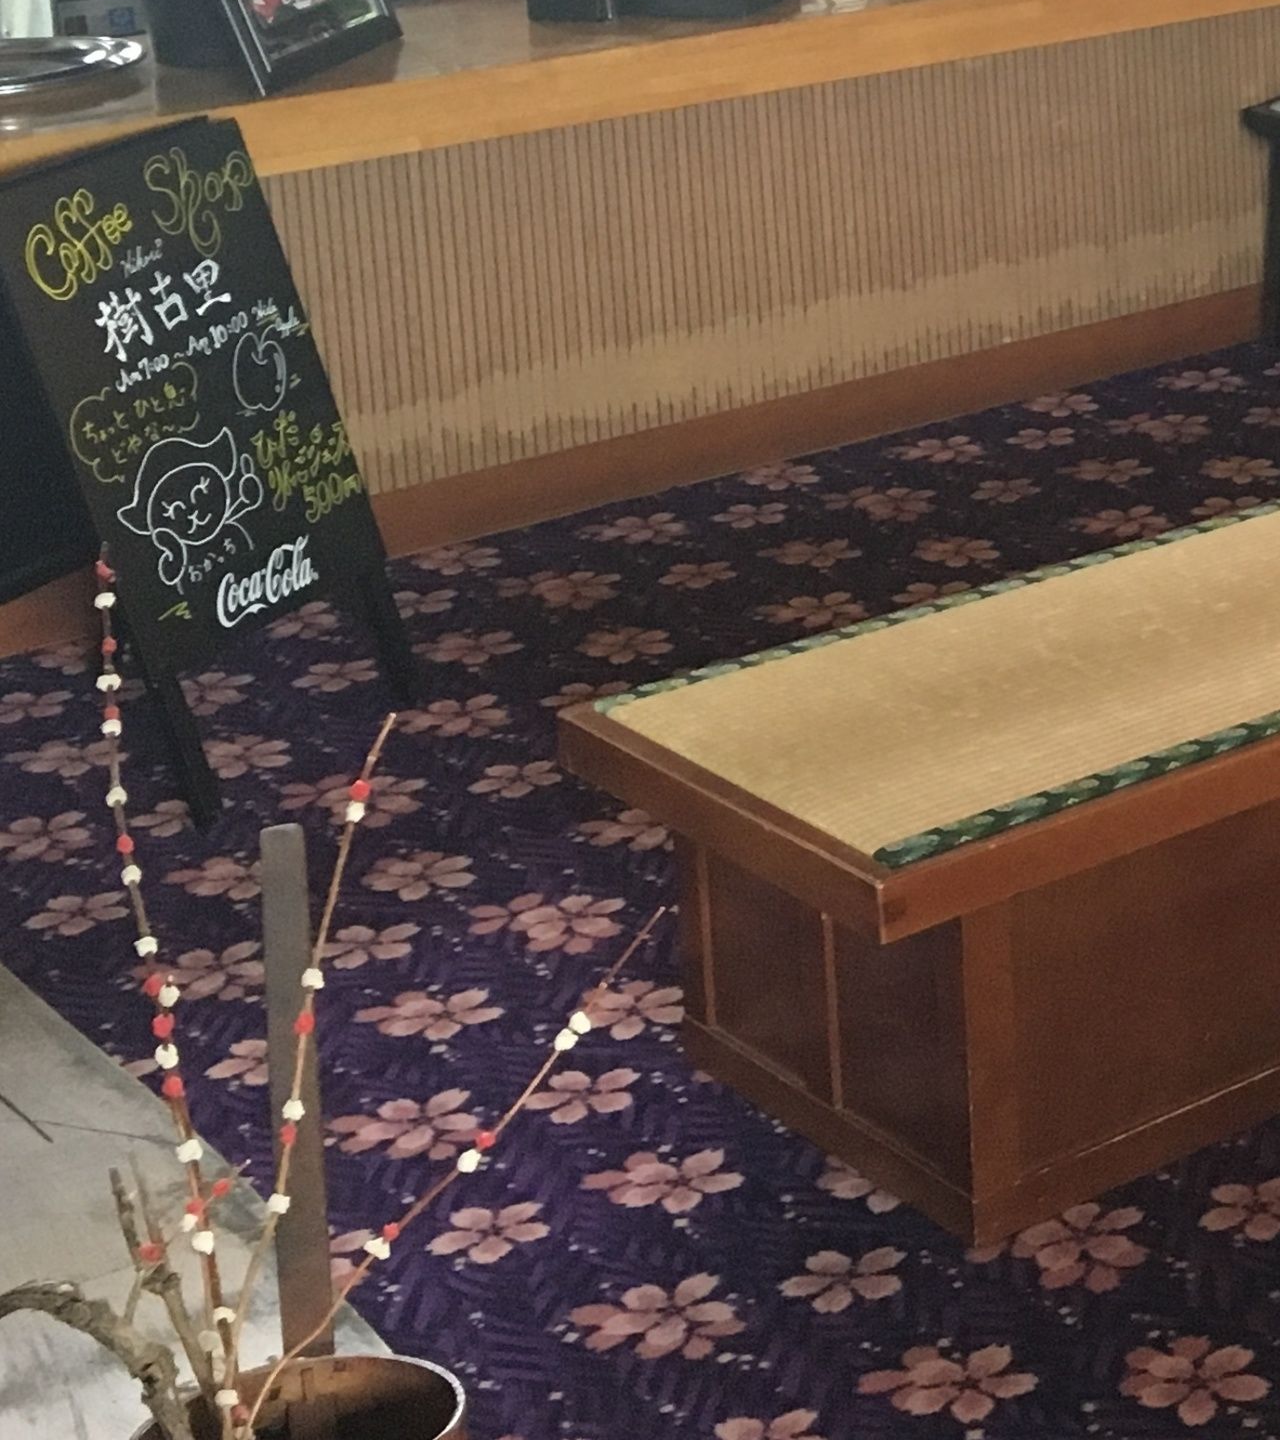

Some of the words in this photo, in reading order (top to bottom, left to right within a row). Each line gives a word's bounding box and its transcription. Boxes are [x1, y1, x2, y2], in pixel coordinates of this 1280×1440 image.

[25, 187, 133, 301] Coffee
[143, 146, 254, 258] Shop
[94, 258, 232, 362] 樹古里
[81, 410, 129, 444] ちょっと
[216, 534, 320, 628] Coca-Cola
